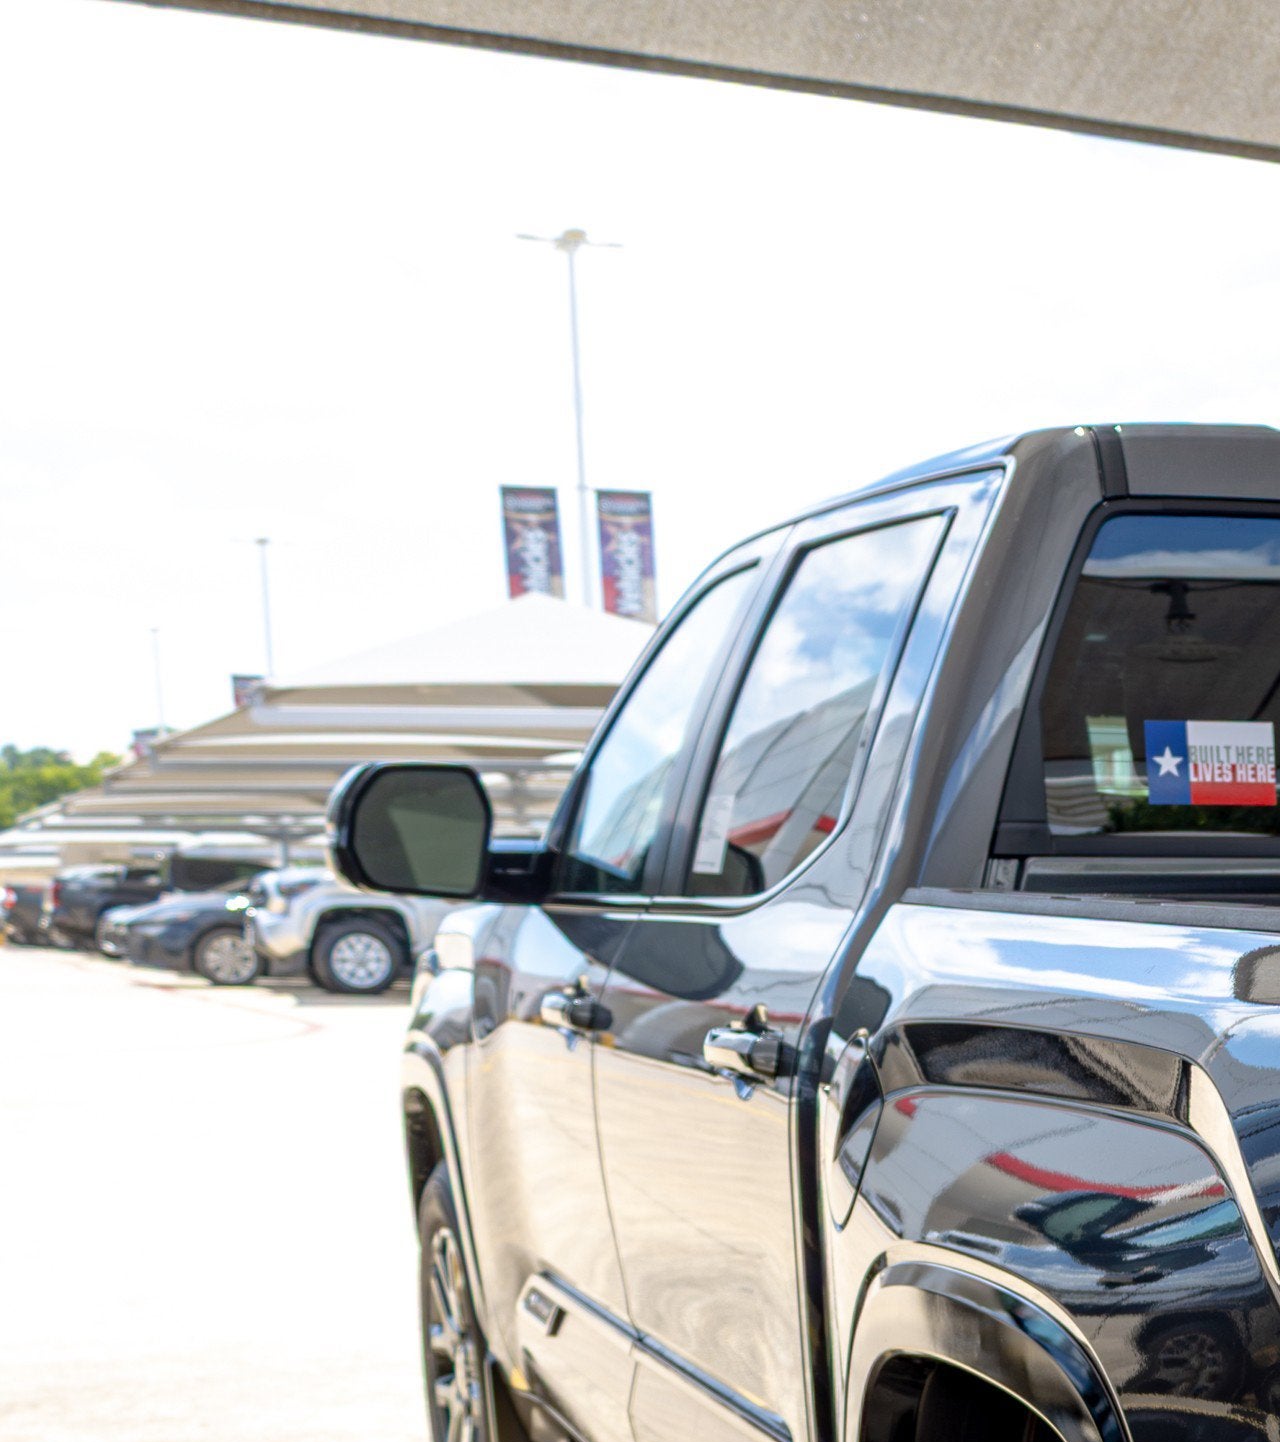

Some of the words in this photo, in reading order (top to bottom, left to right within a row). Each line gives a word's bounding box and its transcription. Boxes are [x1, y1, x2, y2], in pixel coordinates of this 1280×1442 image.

[1187, 745, 1233, 765] BUILT
[1235, 746, 1275, 764] HERE
[1190, 763, 1234, 783] LIVES
[1236, 764, 1276, 783] HERE
